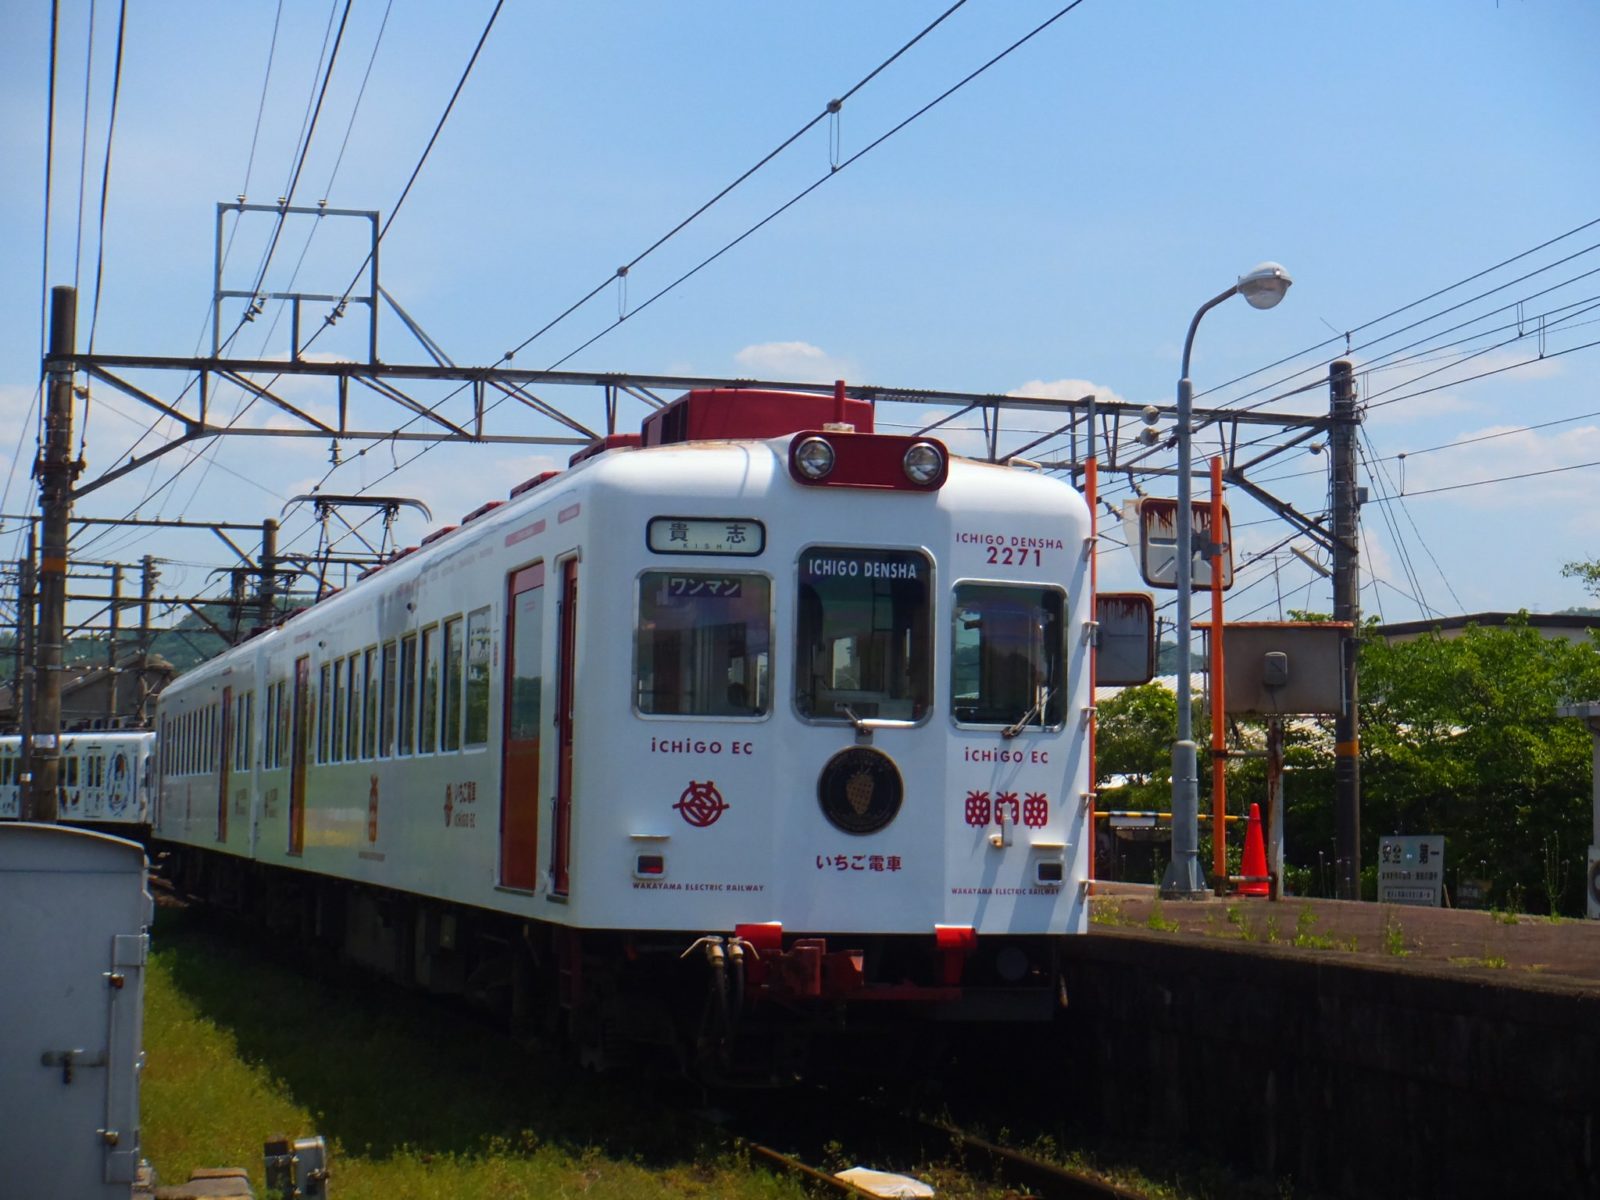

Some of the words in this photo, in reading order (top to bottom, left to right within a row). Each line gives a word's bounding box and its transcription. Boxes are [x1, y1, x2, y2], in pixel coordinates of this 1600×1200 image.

[669, 521, 747, 544] 貴志
[956, 532, 1005, 546] ICHIGO
[1010, 536, 1064, 550] DENSHA
[986, 546, 1041, 567] 2271
[808, 559, 858, 577] ICHIGO
[863, 562, 917, 579] DENSHA
[670, 578, 741, 596] ワンマン
[731, 741, 753, 755] EC
[1031, 751, 1049, 765] EC
[816, 854, 902, 872] いちご電車
[632, 882, 682, 891] WAKAYAMA
[685, 883, 723, 892] ELECTRIC
[726, 884, 764, 892] RAILWAY
[951, 887, 992, 896] WAKAYAMA
[995, 888, 1026, 896] ELECTRIC
